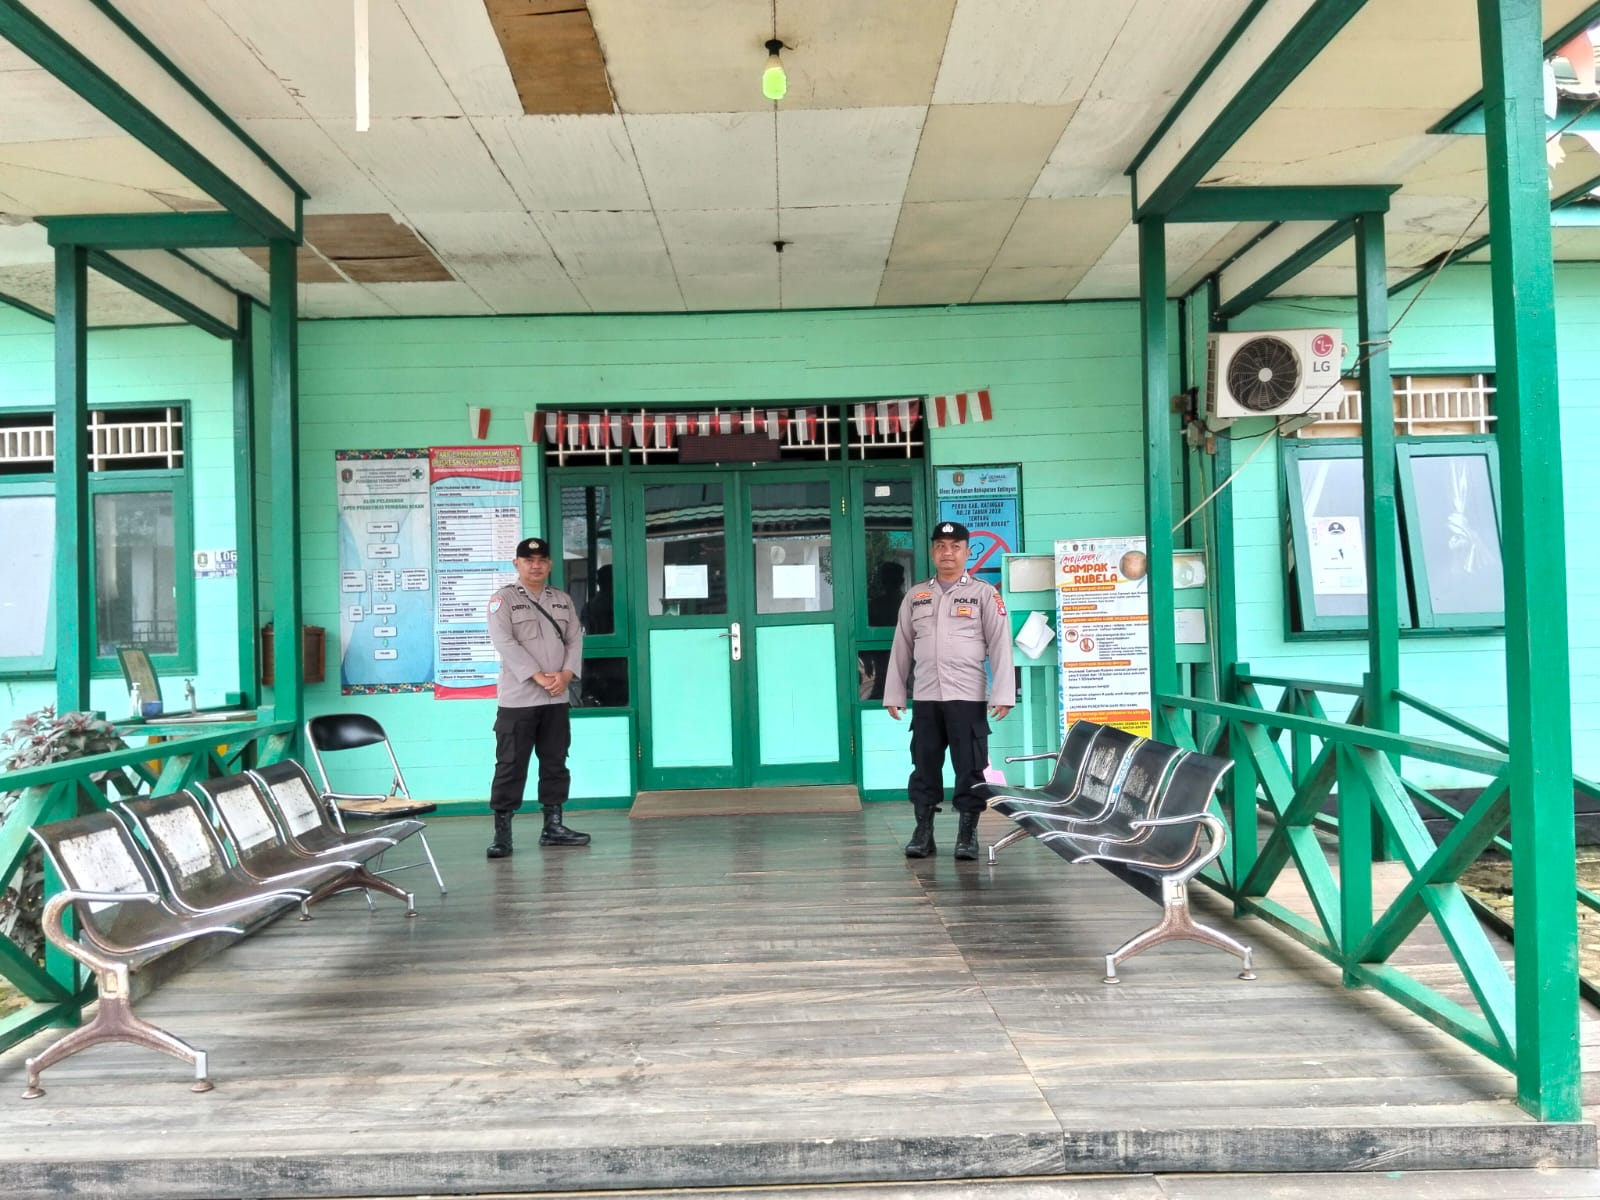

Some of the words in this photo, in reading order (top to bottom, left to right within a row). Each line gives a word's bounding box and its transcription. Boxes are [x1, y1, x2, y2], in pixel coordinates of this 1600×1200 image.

[1313, 361, 1330, 373] LG
[1062, 563, 1108, 574] CAMPAK
[1074, 573, 1118, 585] RUBELA
